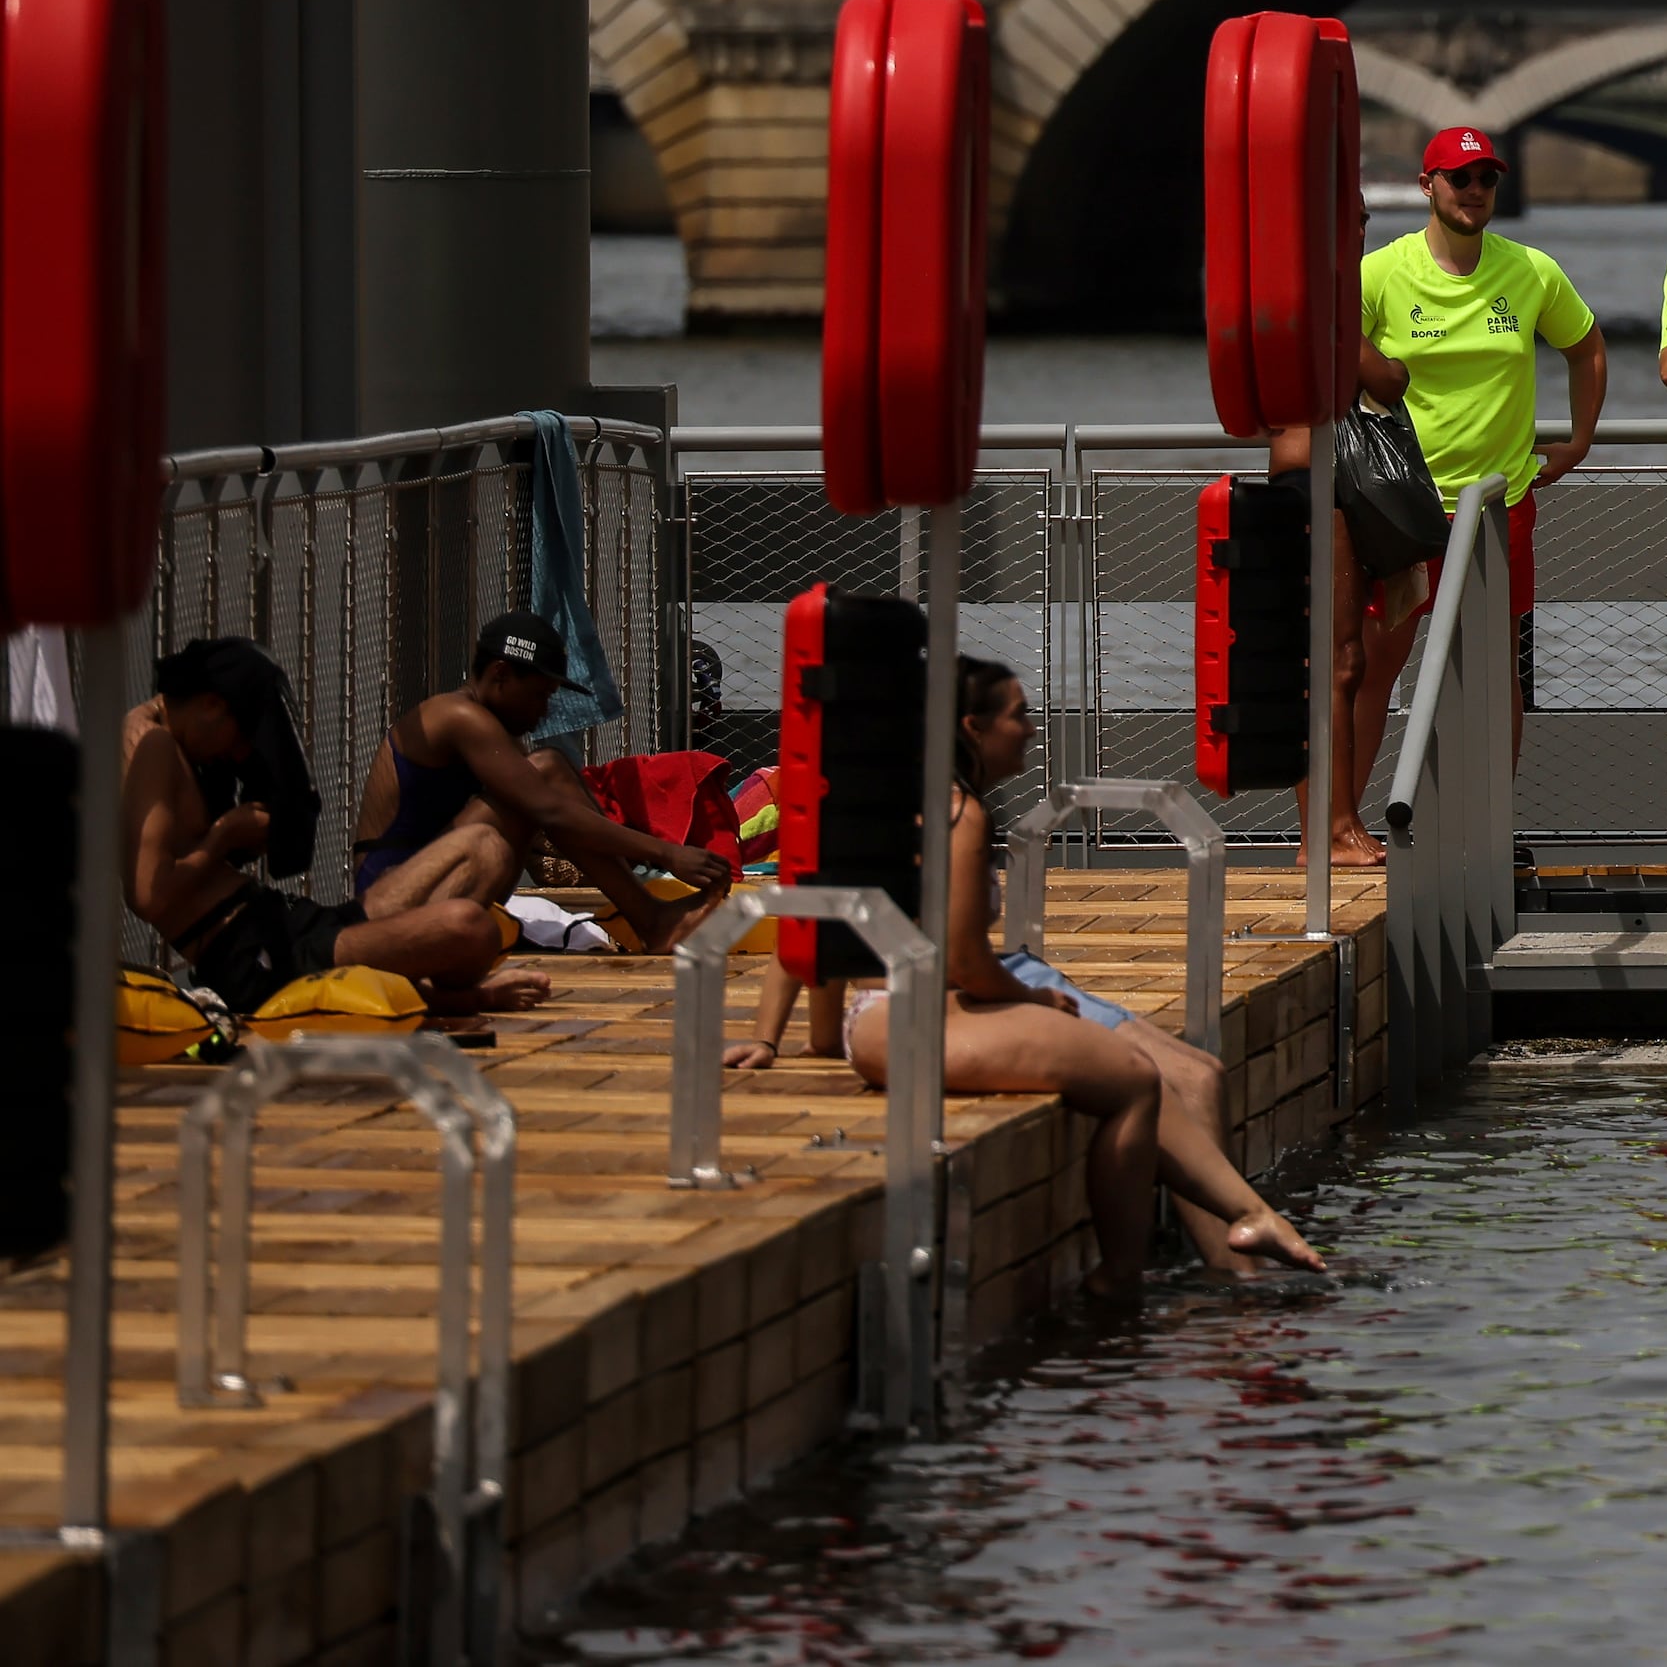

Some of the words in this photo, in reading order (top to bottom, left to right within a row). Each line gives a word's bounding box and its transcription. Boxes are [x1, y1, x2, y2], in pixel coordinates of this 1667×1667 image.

[1487, 315, 1519, 326] PARIS
[1488, 324, 1520, 334] SEINE
[506, 635, 518, 646] GO
[517, 637, 537, 651] WILD
[504, 644, 535, 661] BOSTON
